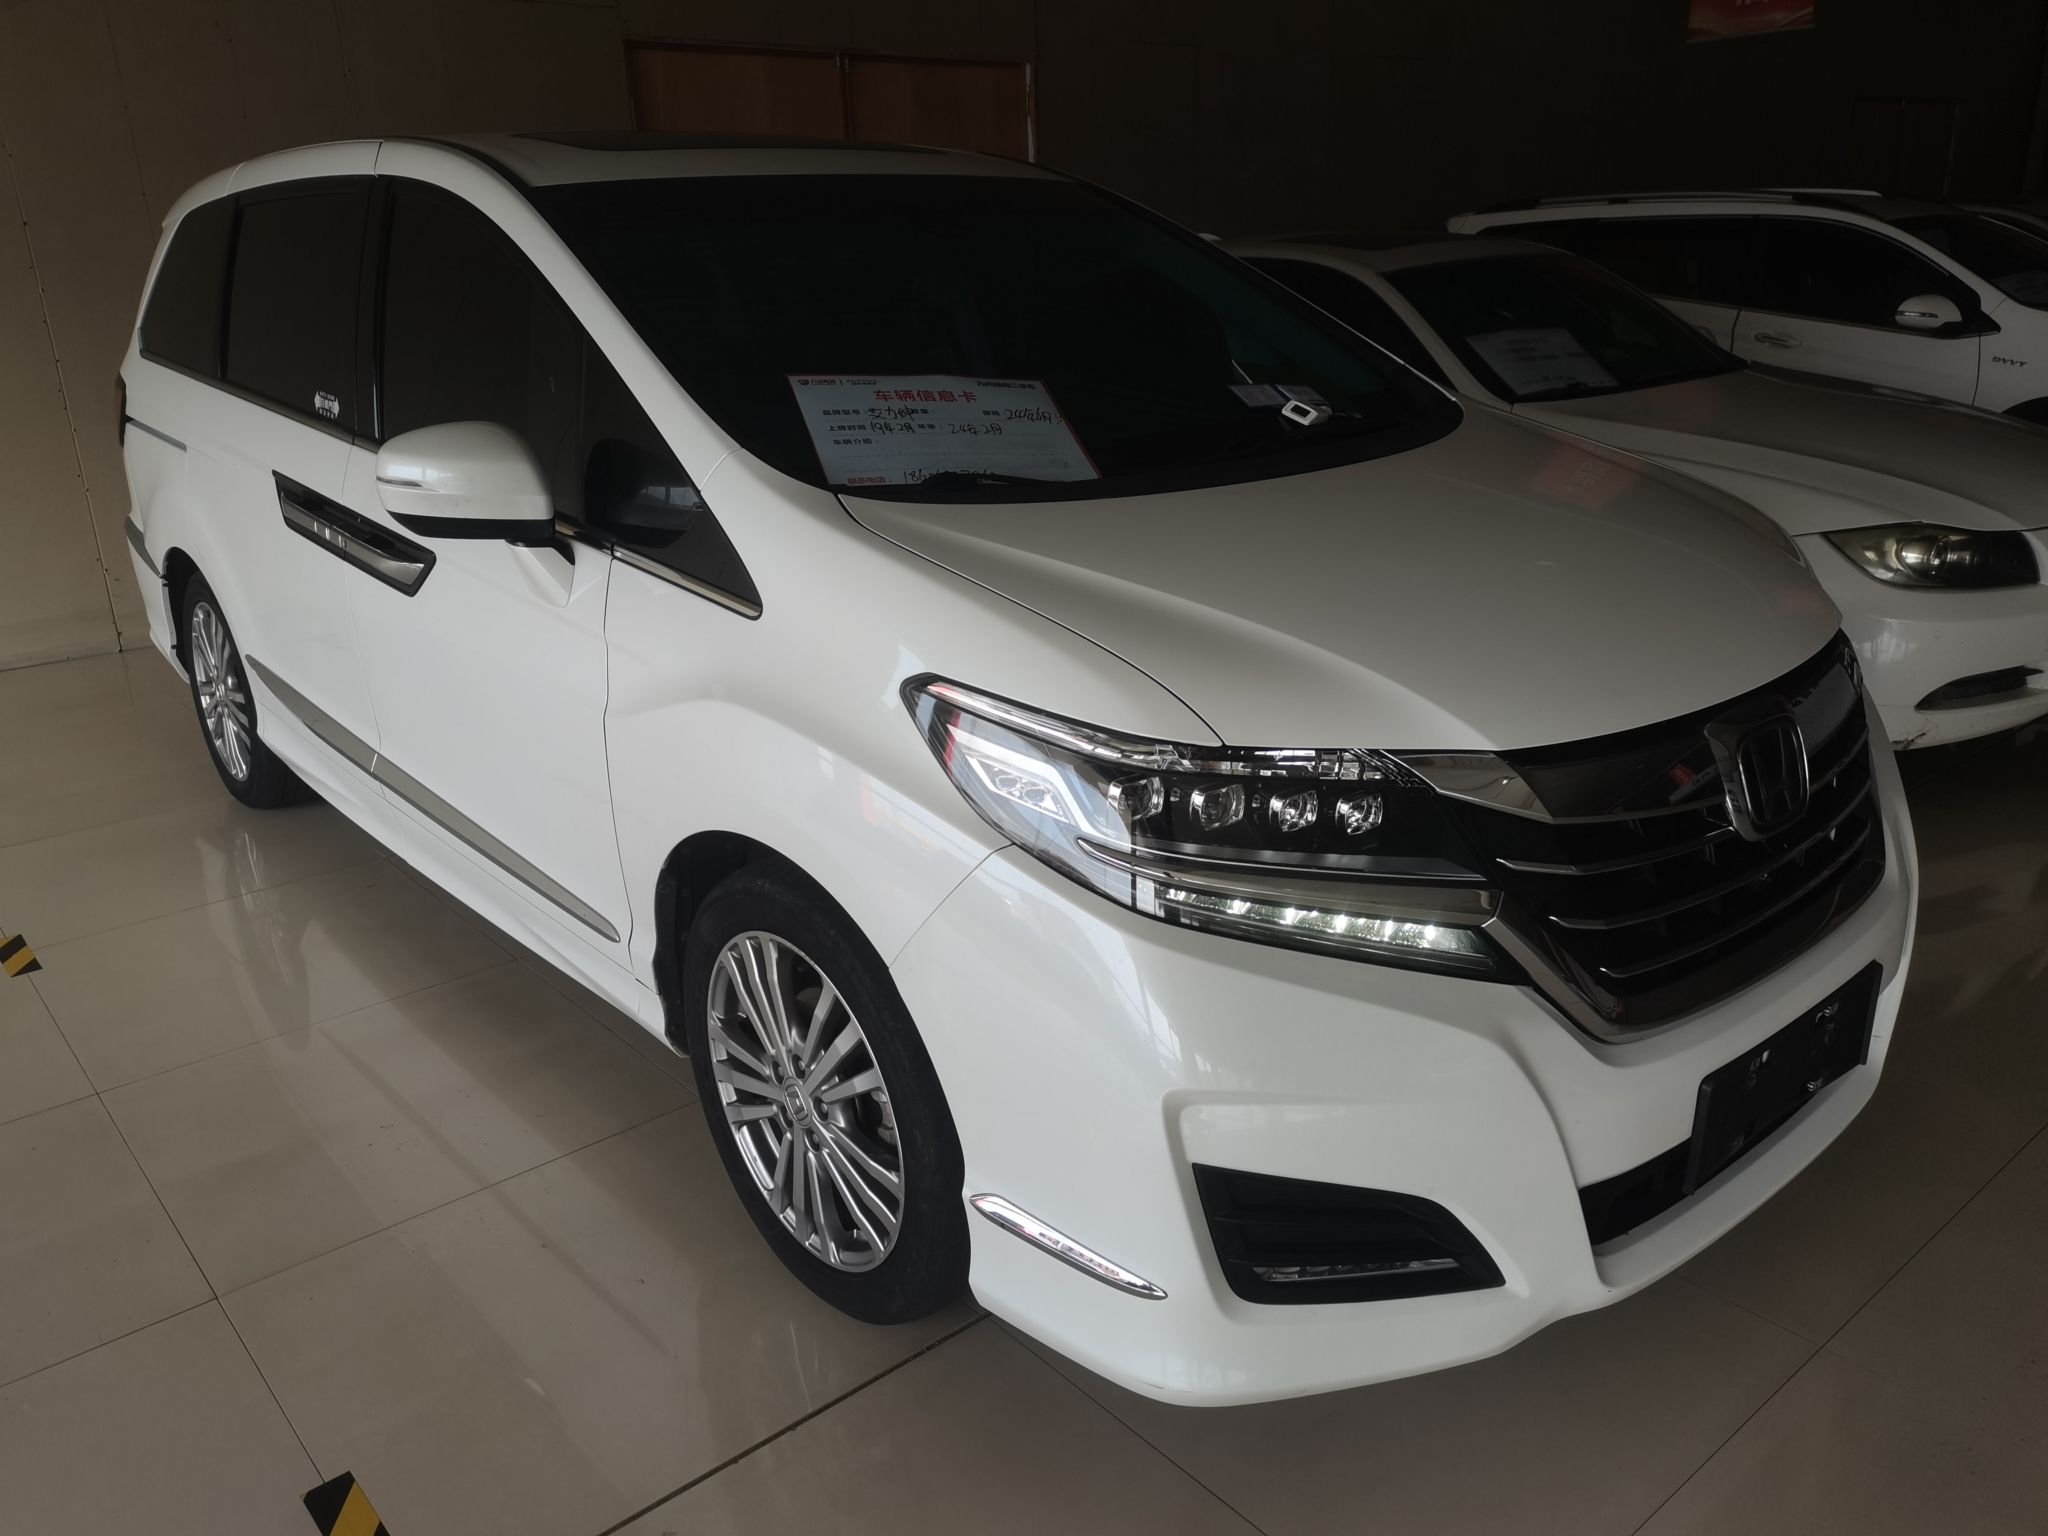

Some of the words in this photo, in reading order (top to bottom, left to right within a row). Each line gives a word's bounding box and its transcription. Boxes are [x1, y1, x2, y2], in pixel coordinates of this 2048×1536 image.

[873, 389, 976, 402] 车辆信息卡
